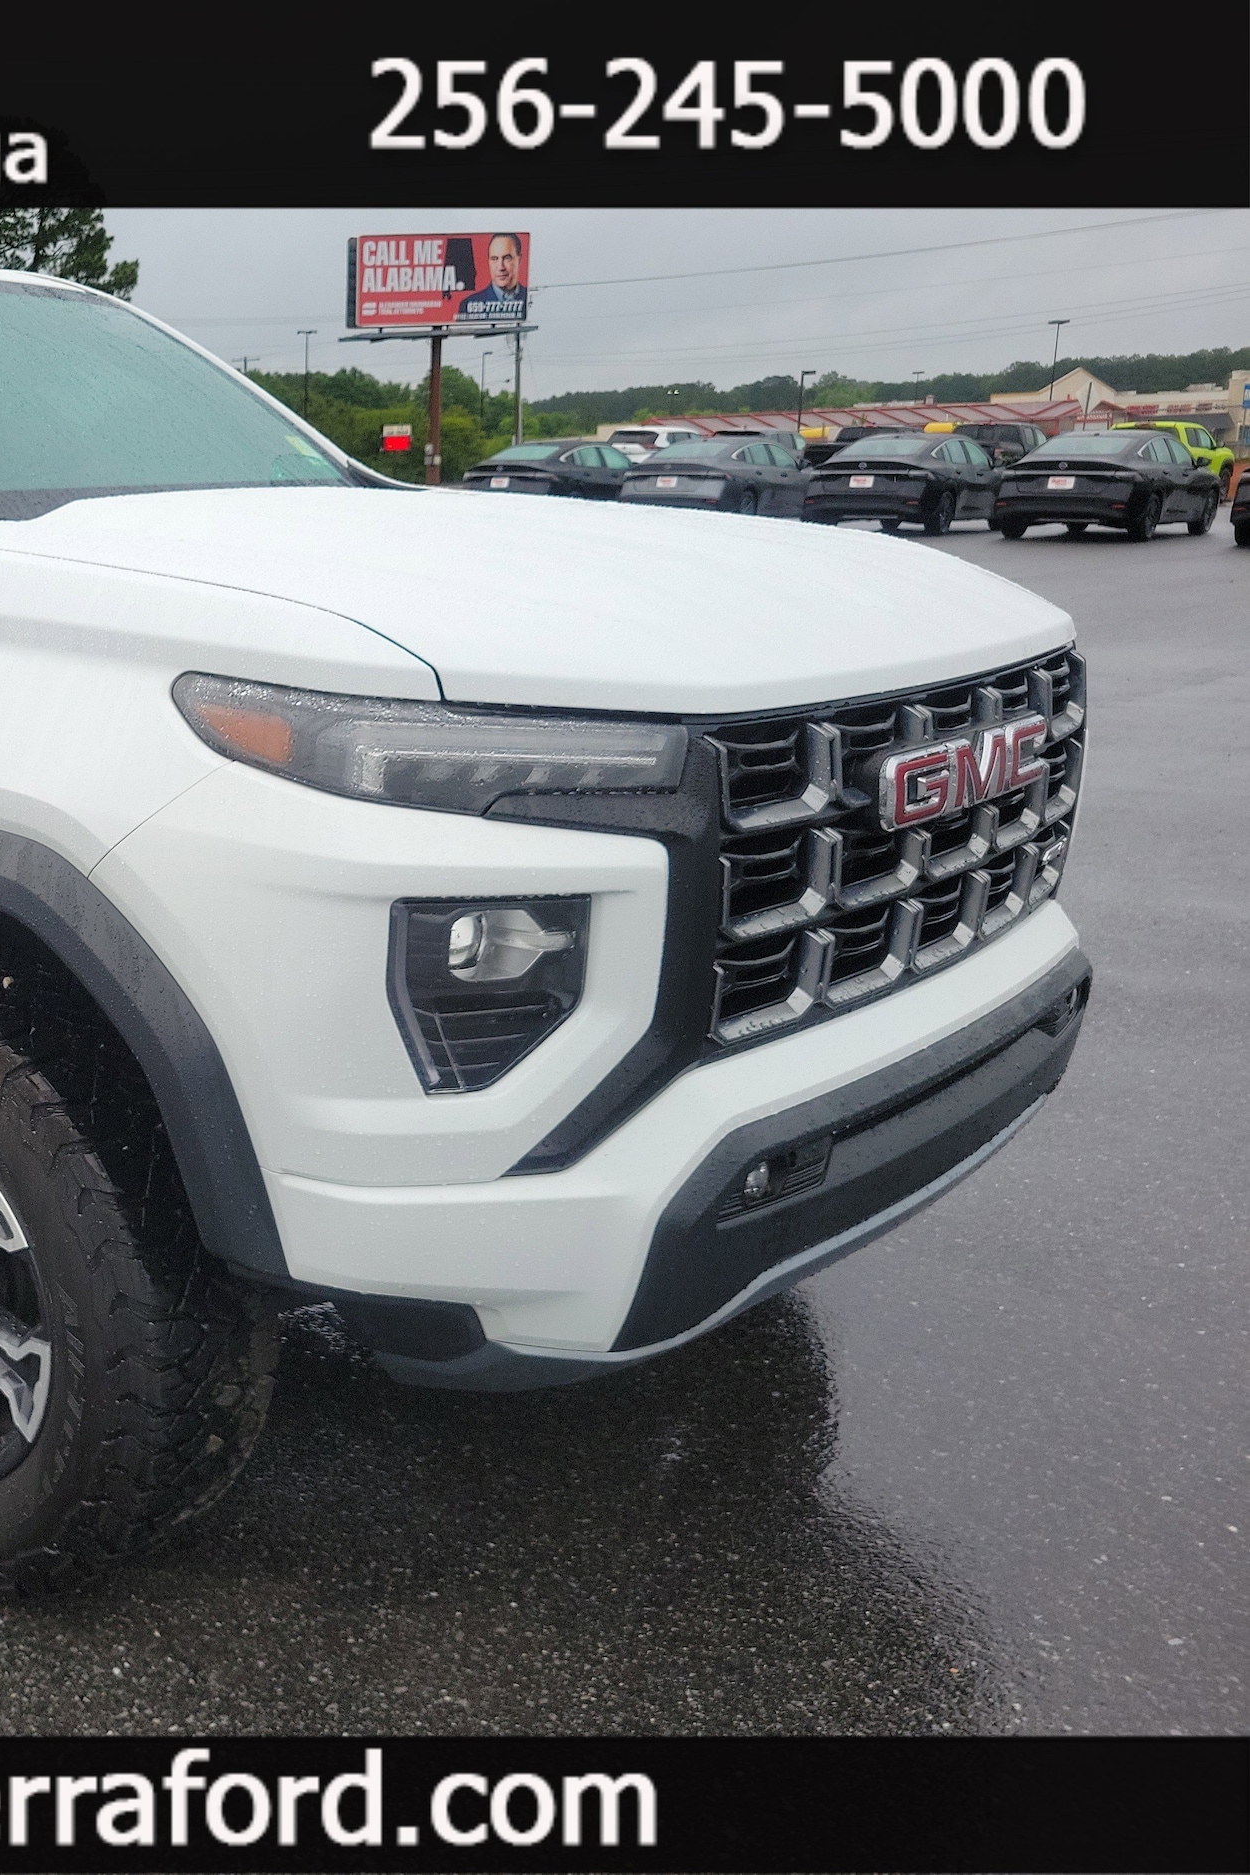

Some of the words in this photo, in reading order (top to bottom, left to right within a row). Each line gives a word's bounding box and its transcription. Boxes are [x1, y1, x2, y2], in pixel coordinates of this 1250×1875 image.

[362, 240, 410, 266] CALL
[414, 240, 443, 264] ME
[361, 265, 466, 293] ALABAMA.
[879, 714, 1050, 832] GMC
